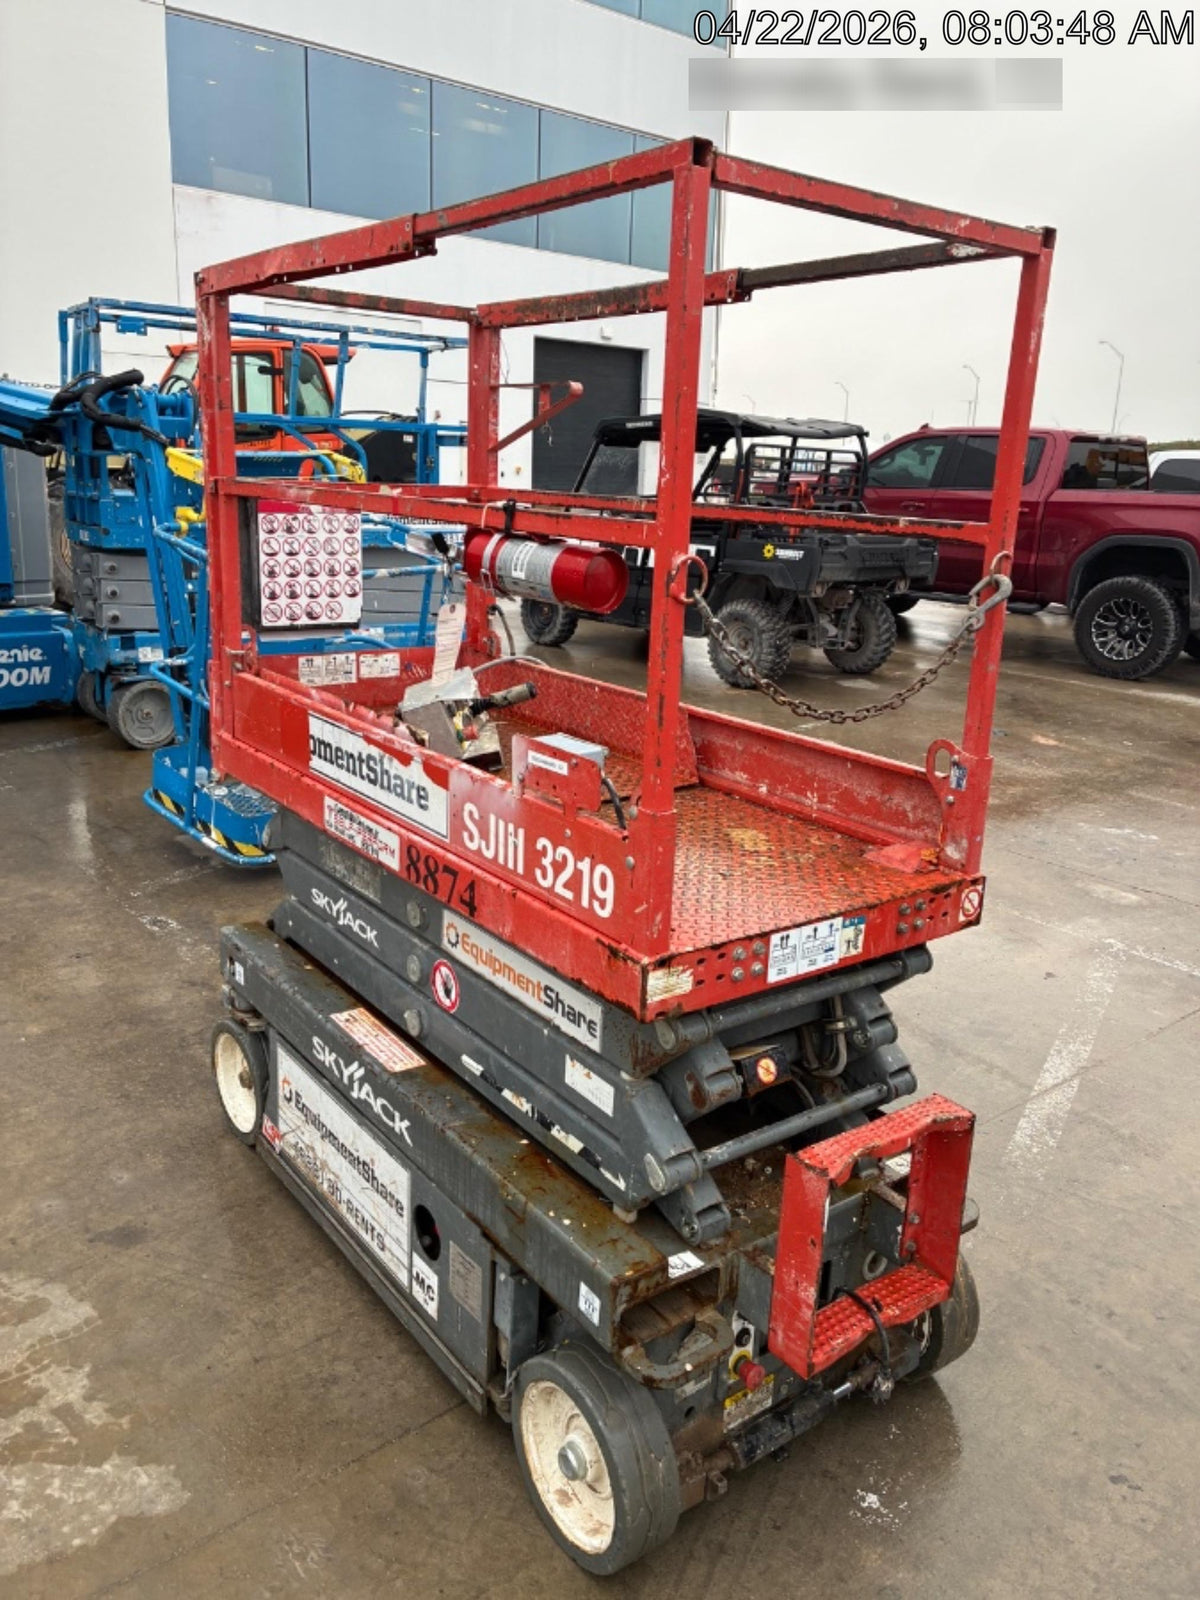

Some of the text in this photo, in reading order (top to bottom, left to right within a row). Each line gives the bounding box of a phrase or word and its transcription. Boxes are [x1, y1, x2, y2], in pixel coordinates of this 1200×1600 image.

[311, 888, 379, 948] SKYJACK
[406, 844, 478, 918] 8874
[535, 837, 614, 918] 3219
[461, 933, 598, 1039] EquipmentShare
[312, 1036, 413, 1147] SKYJACK
[295, 1092, 405, 1218] EquipmentShare
